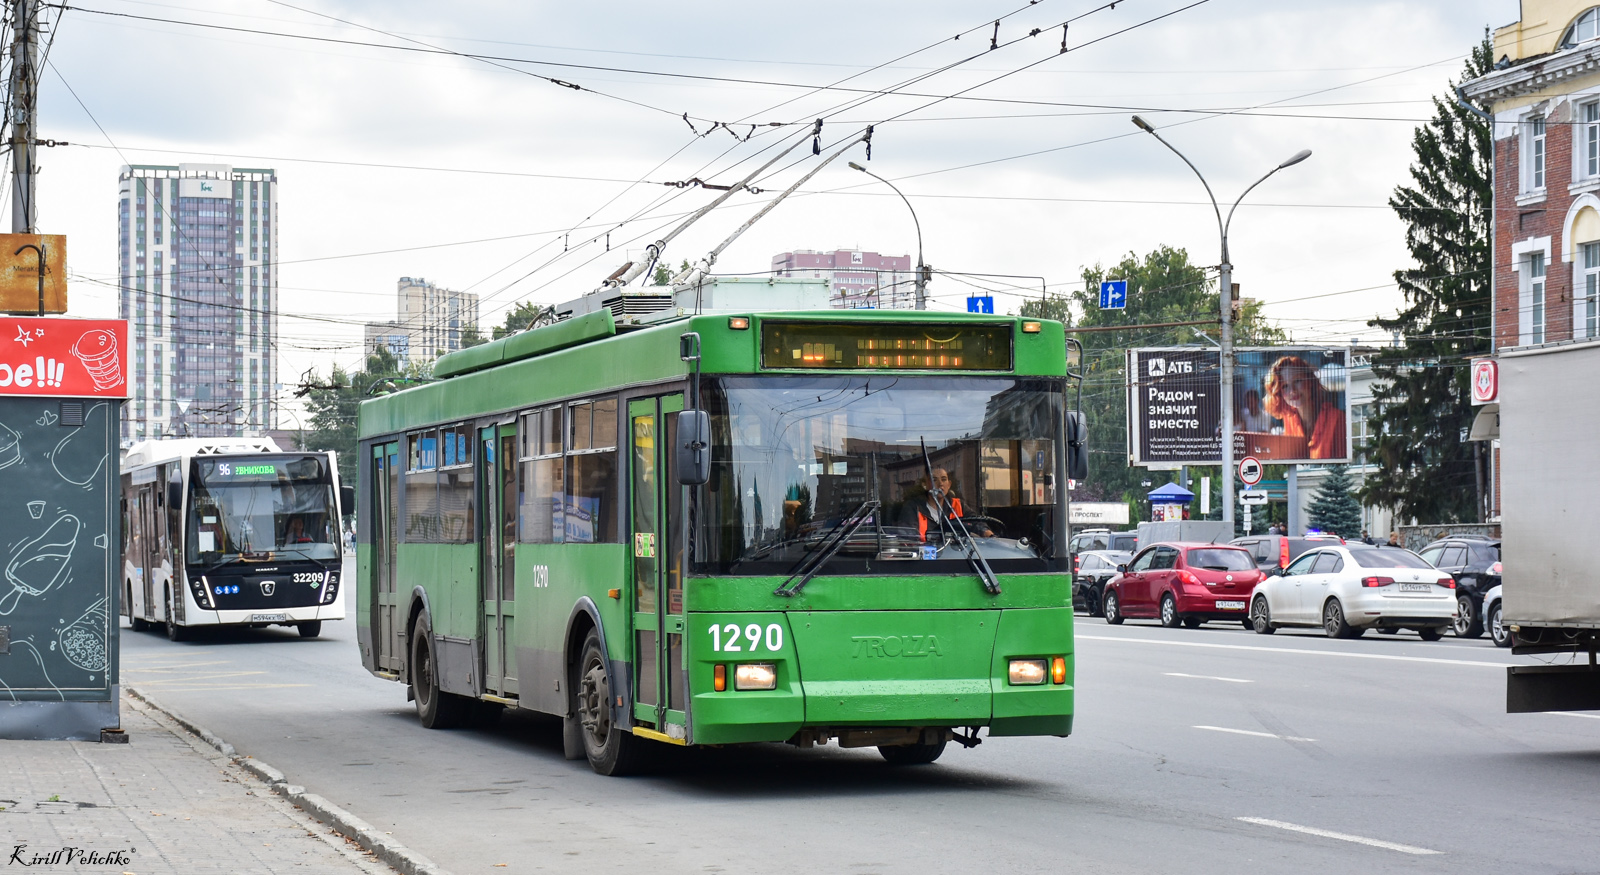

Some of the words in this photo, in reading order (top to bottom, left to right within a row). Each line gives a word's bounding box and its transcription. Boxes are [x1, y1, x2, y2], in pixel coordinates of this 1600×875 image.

[1167, 361, 1193, 374] АТБ
[1148, 388, 1193, 402] Рядом
[1148, 405, 1197, 415] значит
[1149, 419, 1200, 429] вместе
[219, 463, 231, 475] 96
[293, 573, 324, 583] 32209
[533, 564, 549, 588] 1290
[708, 623, 783, 652] 1290
[851, 635, 944, 659] TROLZA
